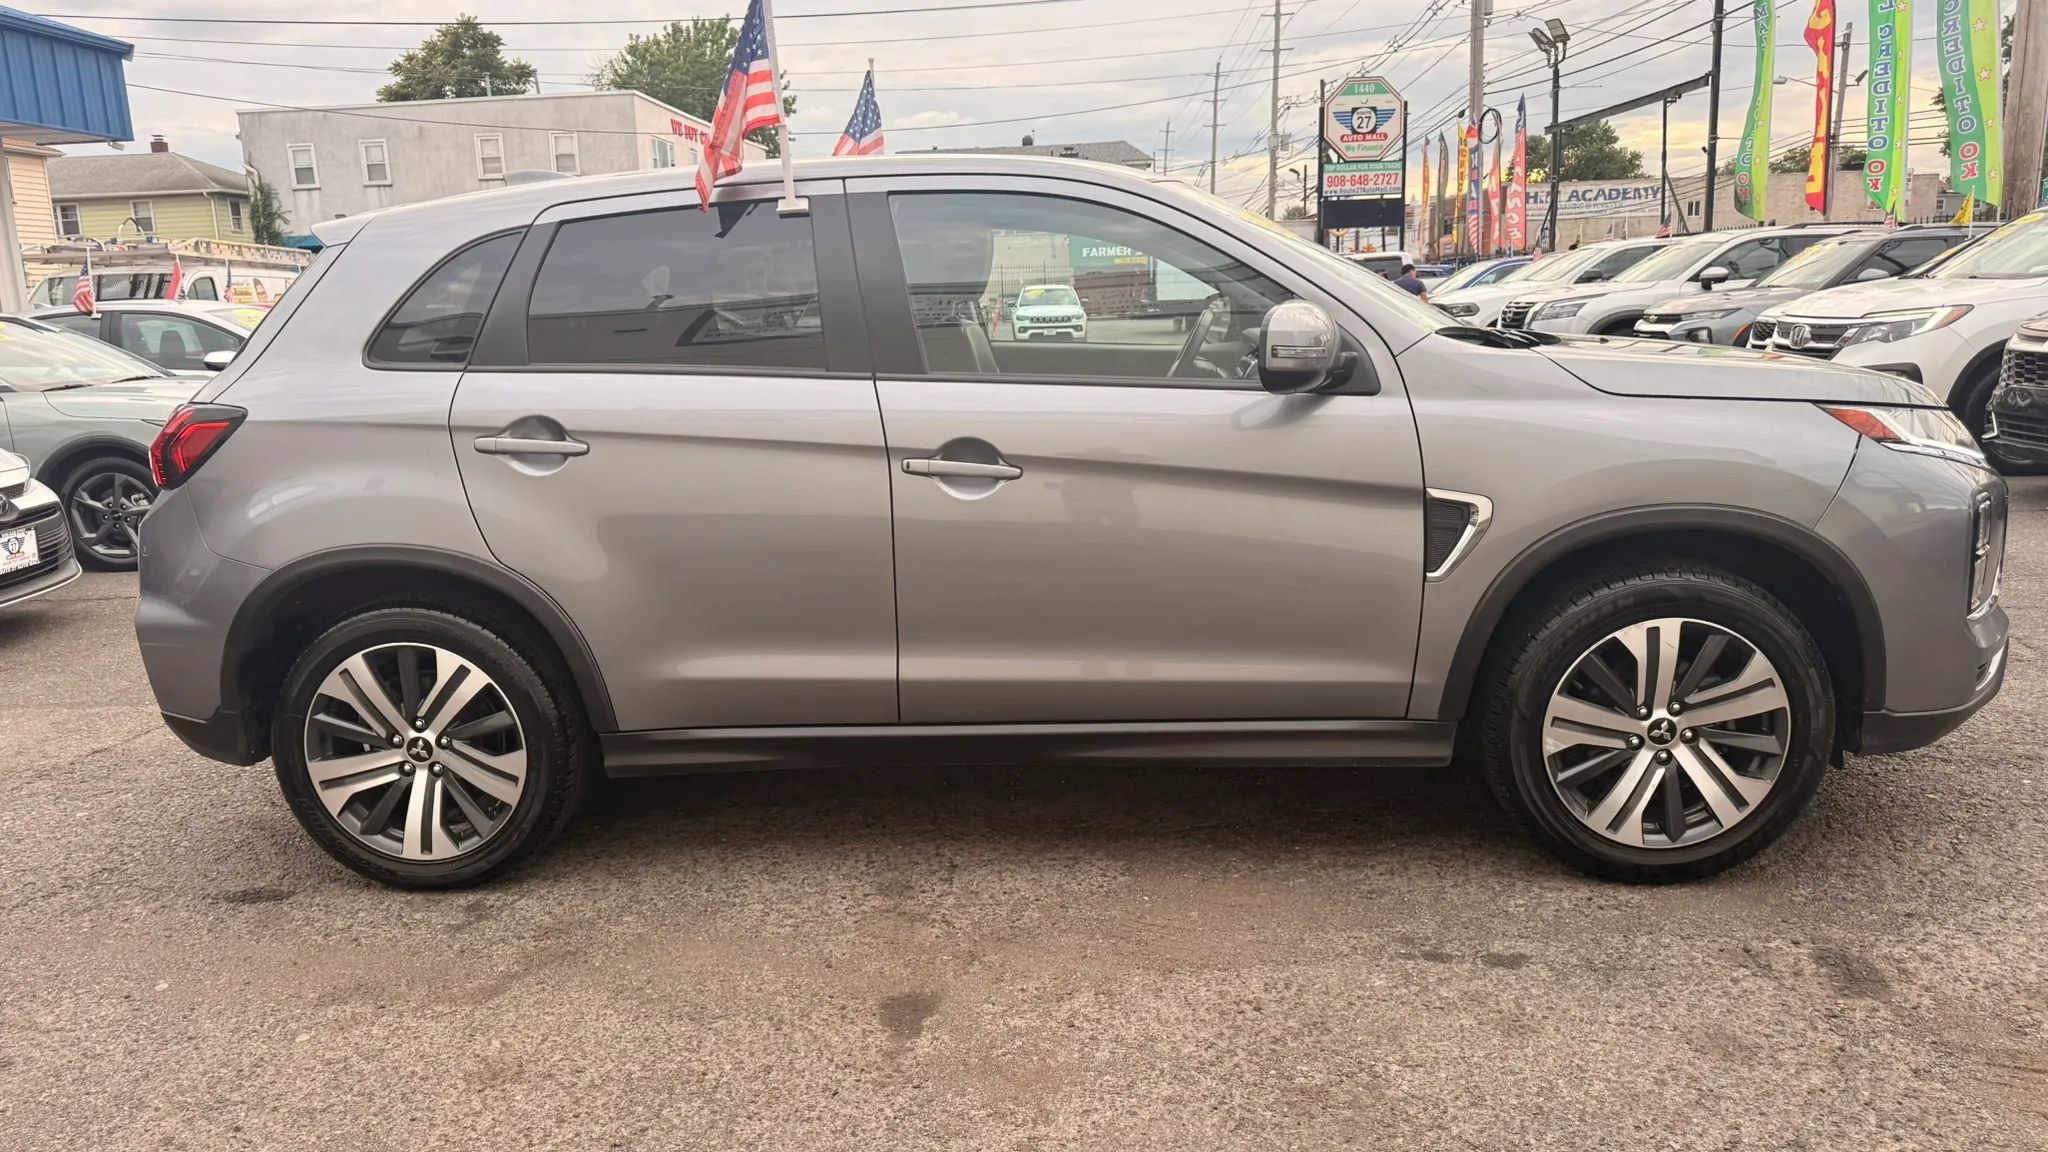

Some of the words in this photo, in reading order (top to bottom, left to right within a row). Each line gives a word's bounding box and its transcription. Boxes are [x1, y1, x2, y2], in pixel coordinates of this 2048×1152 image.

[1354, 83, 1375, 94] 1440
[1356, 115, 1372, 130] 27
[671, 119, 683, 137] WE
[684, 125, 698, 142] BUY
[1342, 134, 1364, 142] AUTO
[1364, 133, 1386, 141] MALL
[1327, 173, 1399, 187] 908-648-2727
[1567, 186, 1661, 202] ACADEMY
[1082, 246, 1132, 258] FARMER
